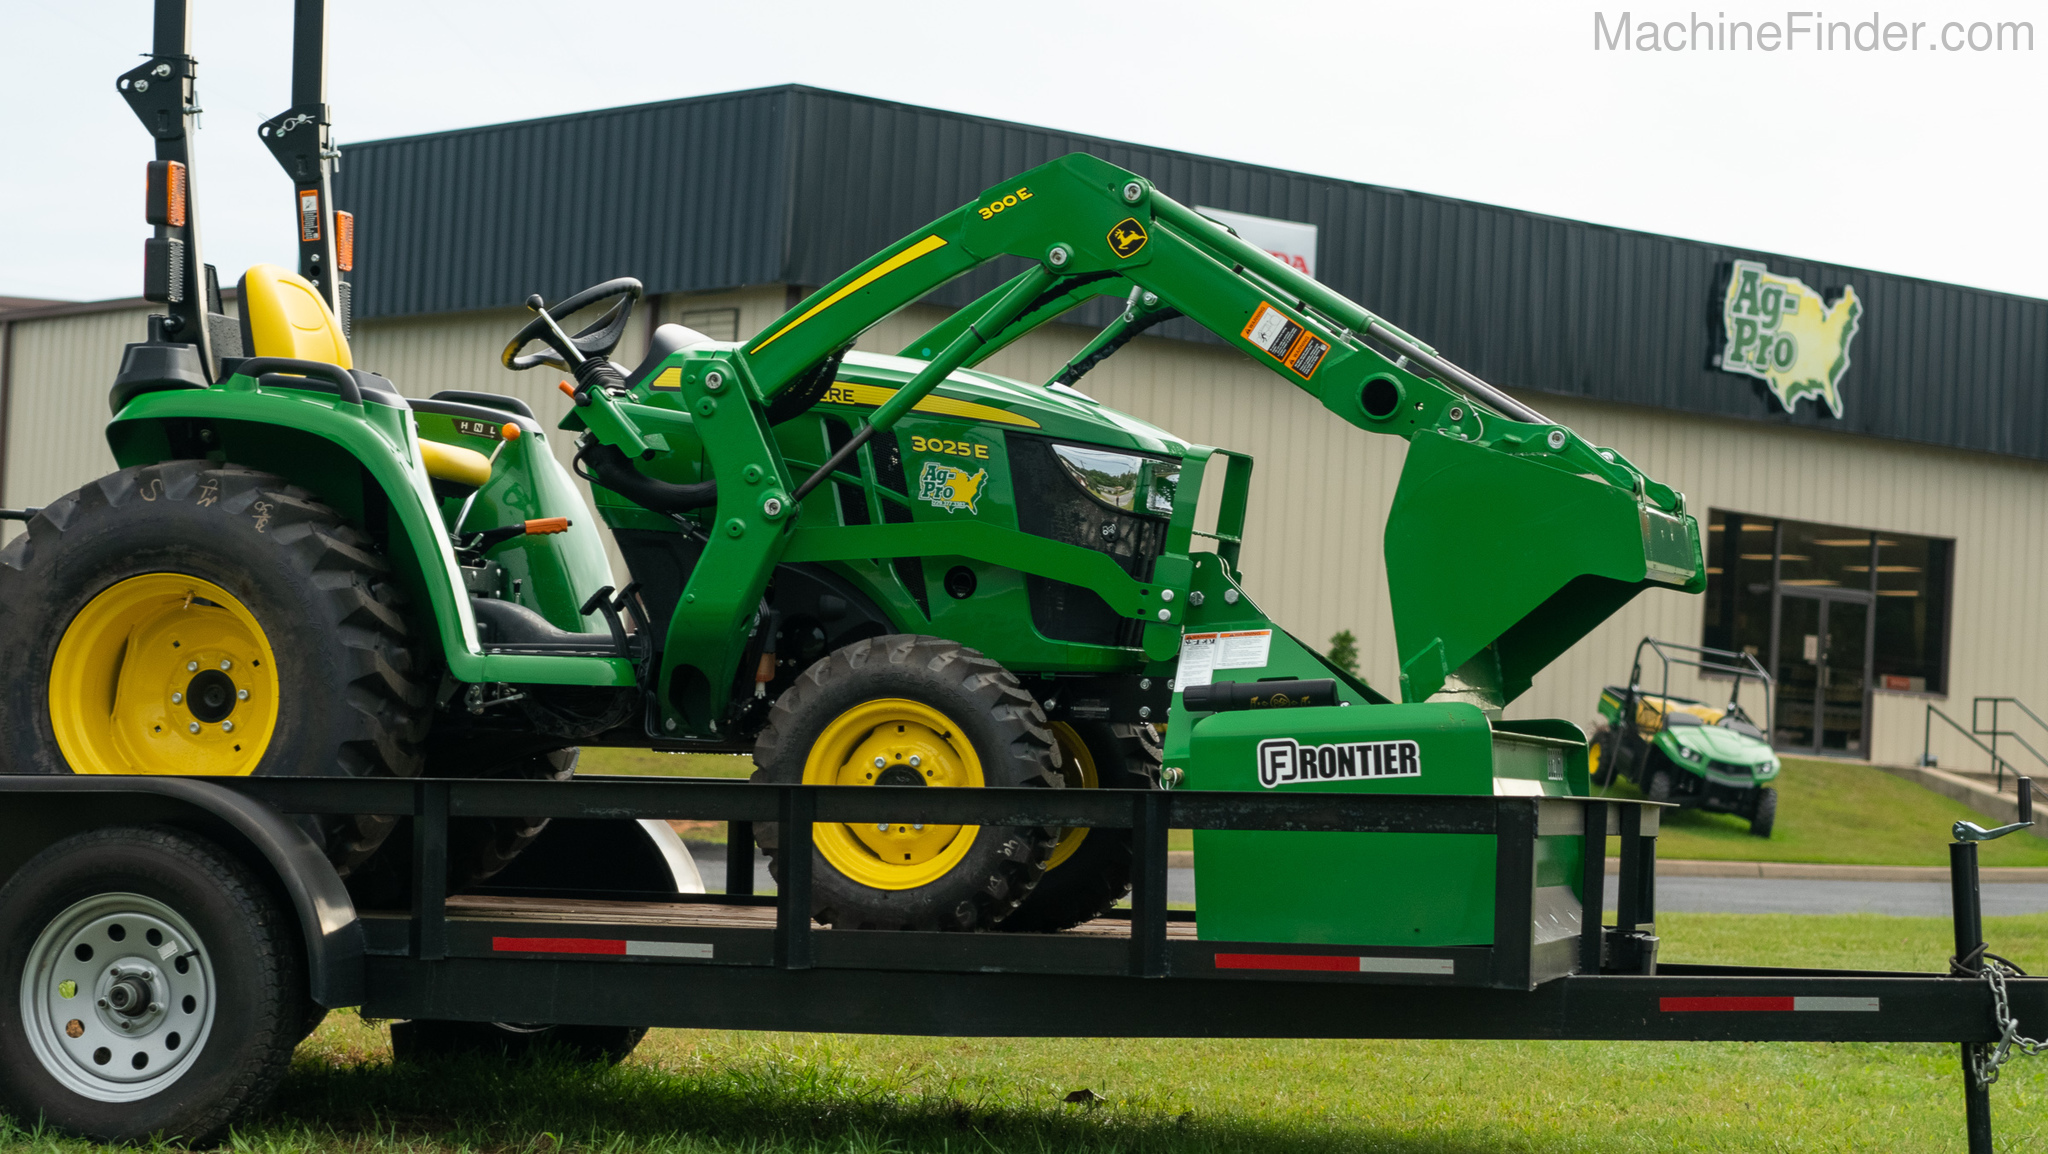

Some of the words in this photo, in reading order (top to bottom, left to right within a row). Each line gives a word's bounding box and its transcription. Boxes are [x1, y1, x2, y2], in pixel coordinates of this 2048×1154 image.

[1732, 269, 1796, 330] Ag-
[1730, 316, 1795, 367] Pro
[821, 387, 856, 403] RE
[921, 481, 955, 500] Pro
[923, 464, 956, 486] Ag-
[1260, 740, 1418, 786] FRONTIER
